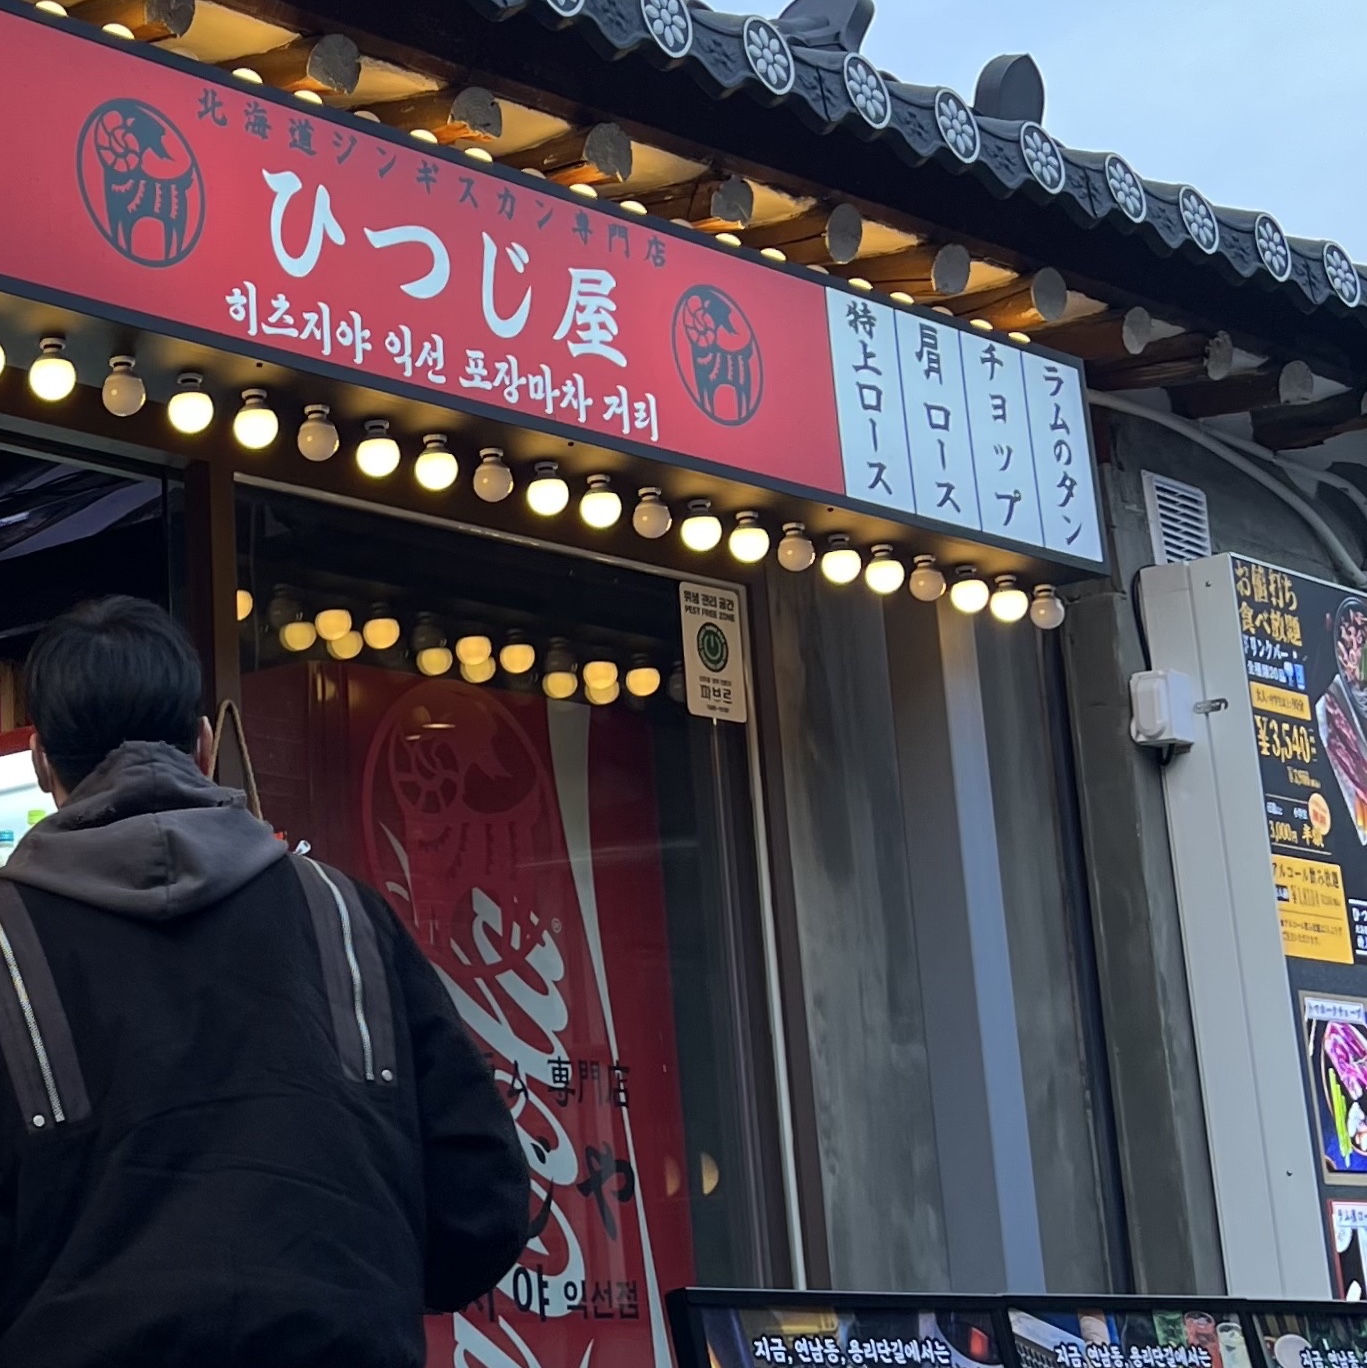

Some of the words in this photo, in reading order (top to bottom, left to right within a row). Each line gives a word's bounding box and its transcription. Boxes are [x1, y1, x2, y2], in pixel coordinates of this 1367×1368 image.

[197, 88, 667, 268] 北海道ジンギスカン専門店
[262, 168, 628, 367] ひつじ屋
[225, 280, 372, 365] 히츠지야
[384, 324, 446, 385] 익선
[459, 348, 593, 423] 포장마차
[603, 385, 661, 442] 거리
[845, 300, 893, 496] 特上ロース
[915, 322, 961, 513] 肩ロース
[980, 343, 1022, 527] チョップ
[1042, 365, 1082, 545] ラムのタン
[1235, 560, 1298, 611] お値打ち
[1239, 601, 1303, 647] 食べ放題
[563, 1280, 639, 1320] 익선점
[753, 1337, 793, 1365] 지금,
[794, 1338, 847, 1365] 연남동,
[848, 1338, 951, 1365] 용리단길에서는
[1055, 1343, 1088, 1368] 지금,
[1088, 1344, 1130, 1368] 연남동,
